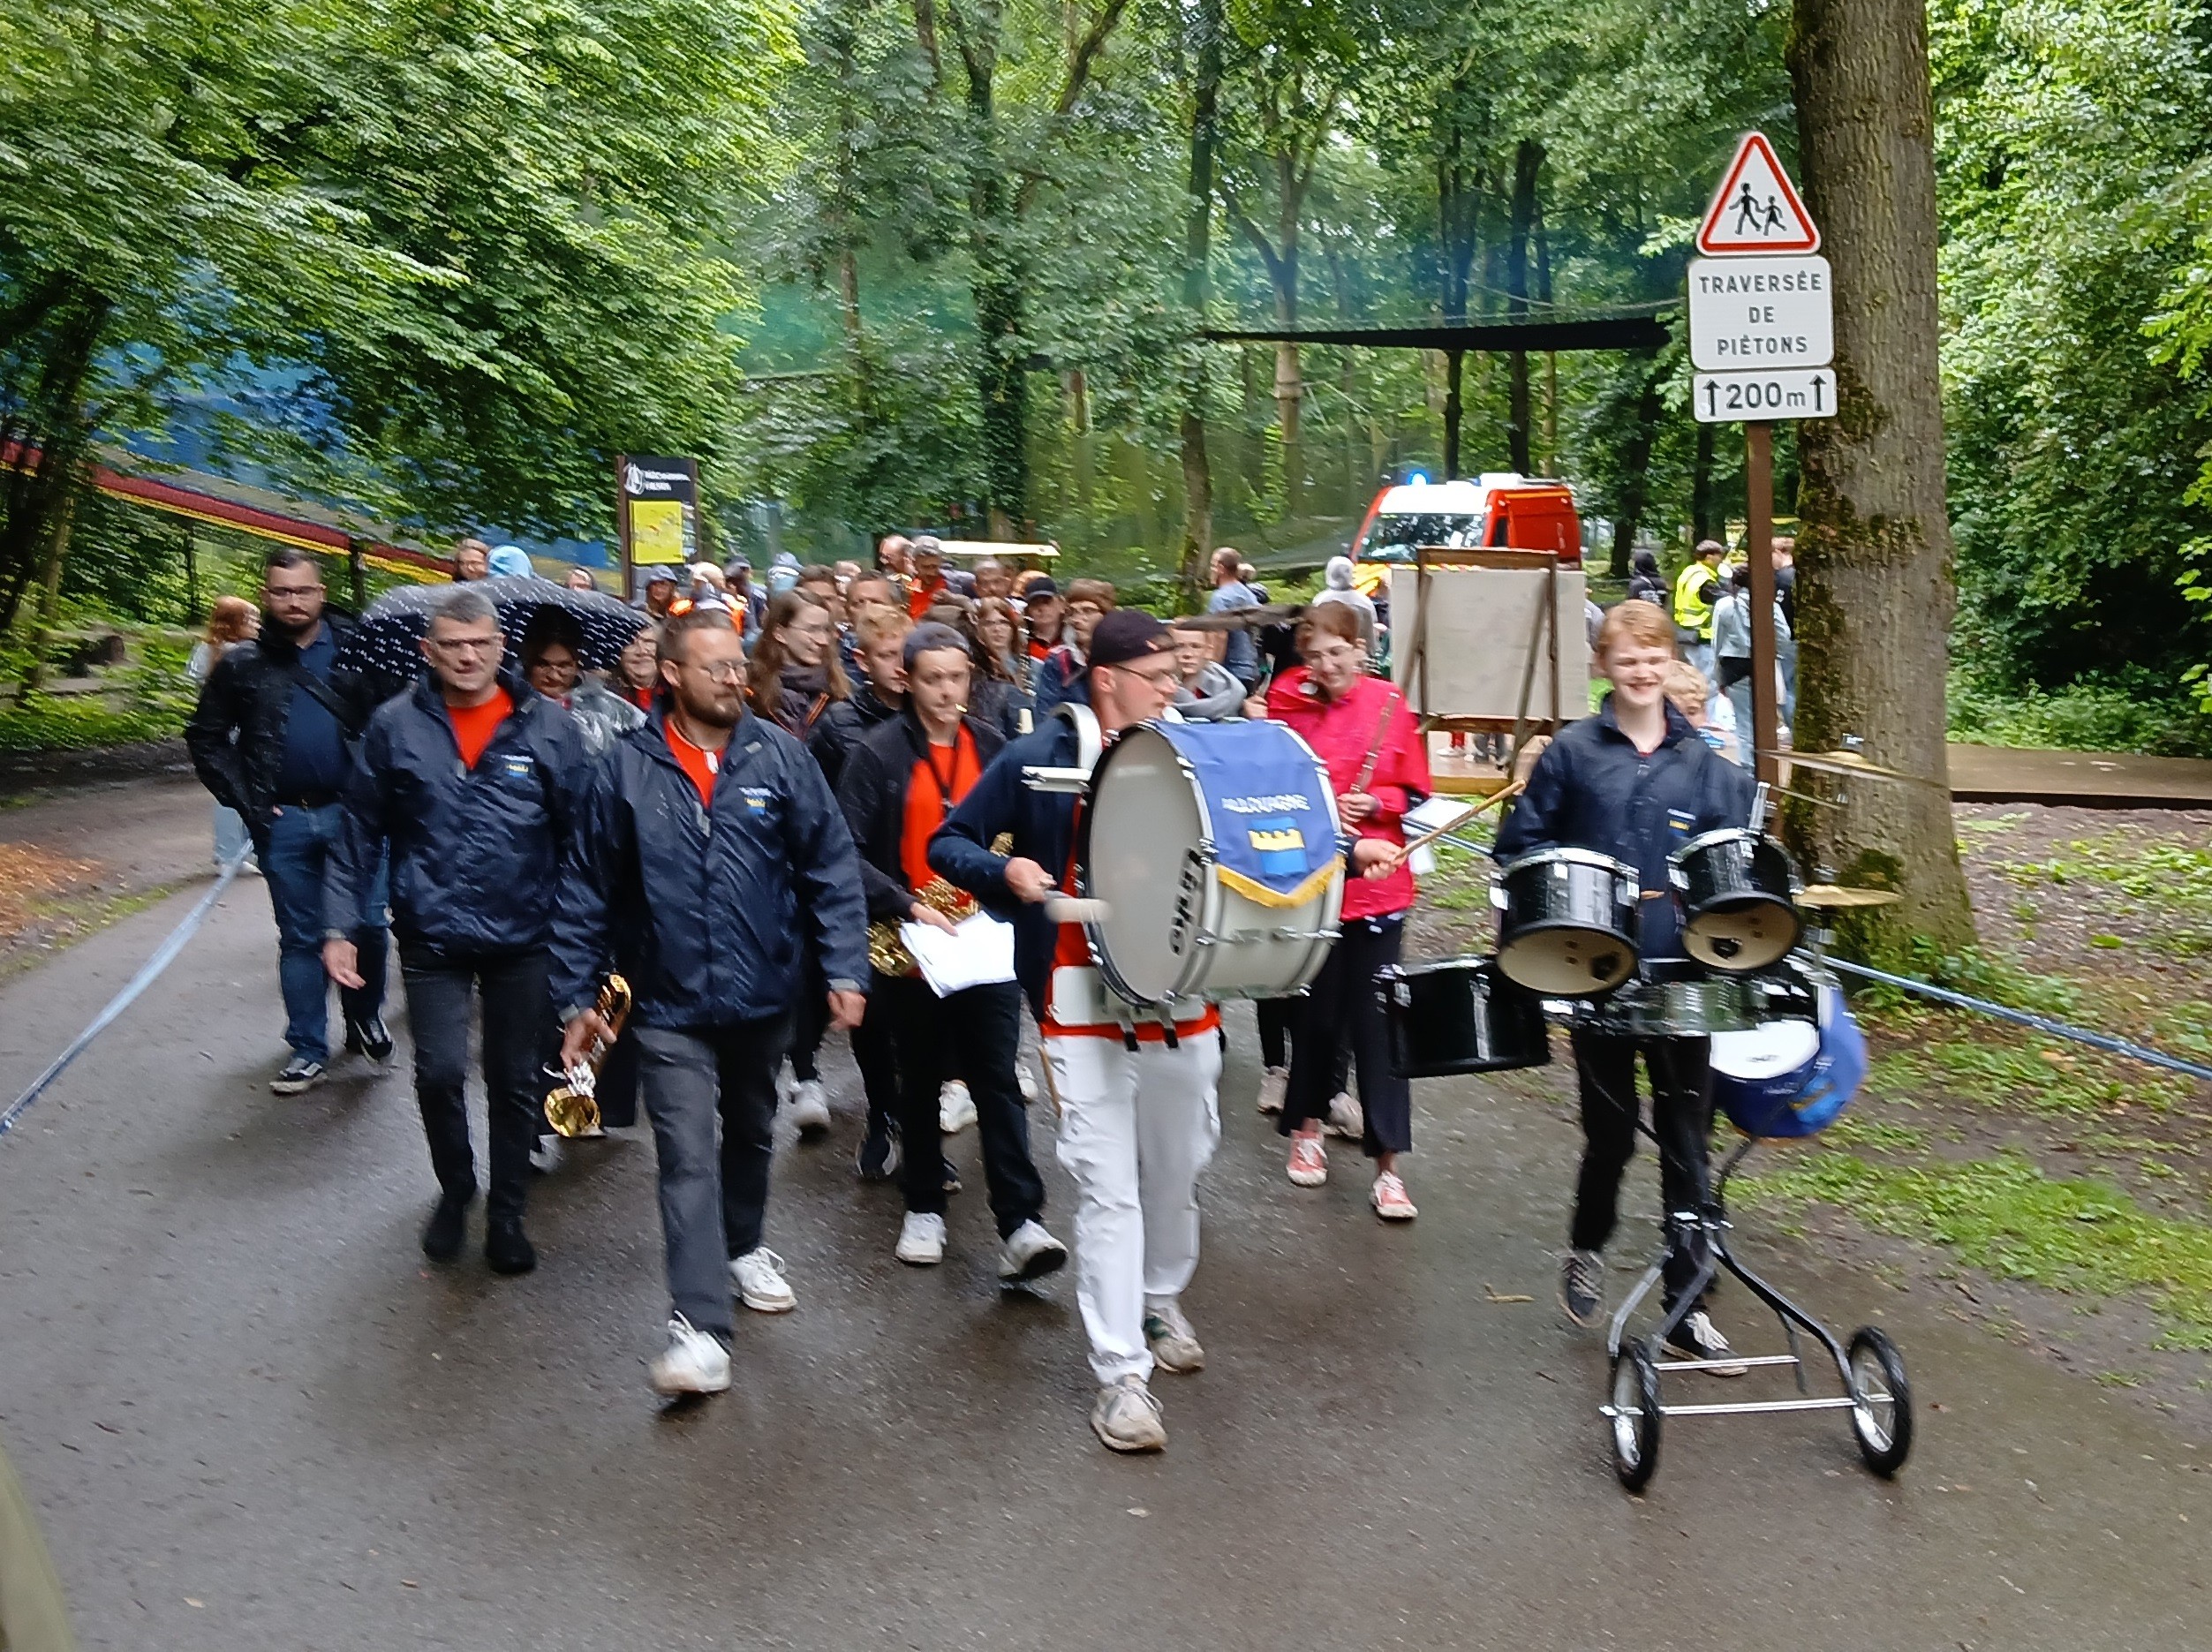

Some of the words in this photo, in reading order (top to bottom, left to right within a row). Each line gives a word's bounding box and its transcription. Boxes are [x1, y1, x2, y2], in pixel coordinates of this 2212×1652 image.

[1699, 270, 1822, 294] TRAVERSÉE
[1748, 306, 1775, 324] DE
[1717, 334, 1808, 355] PIÉTONS
